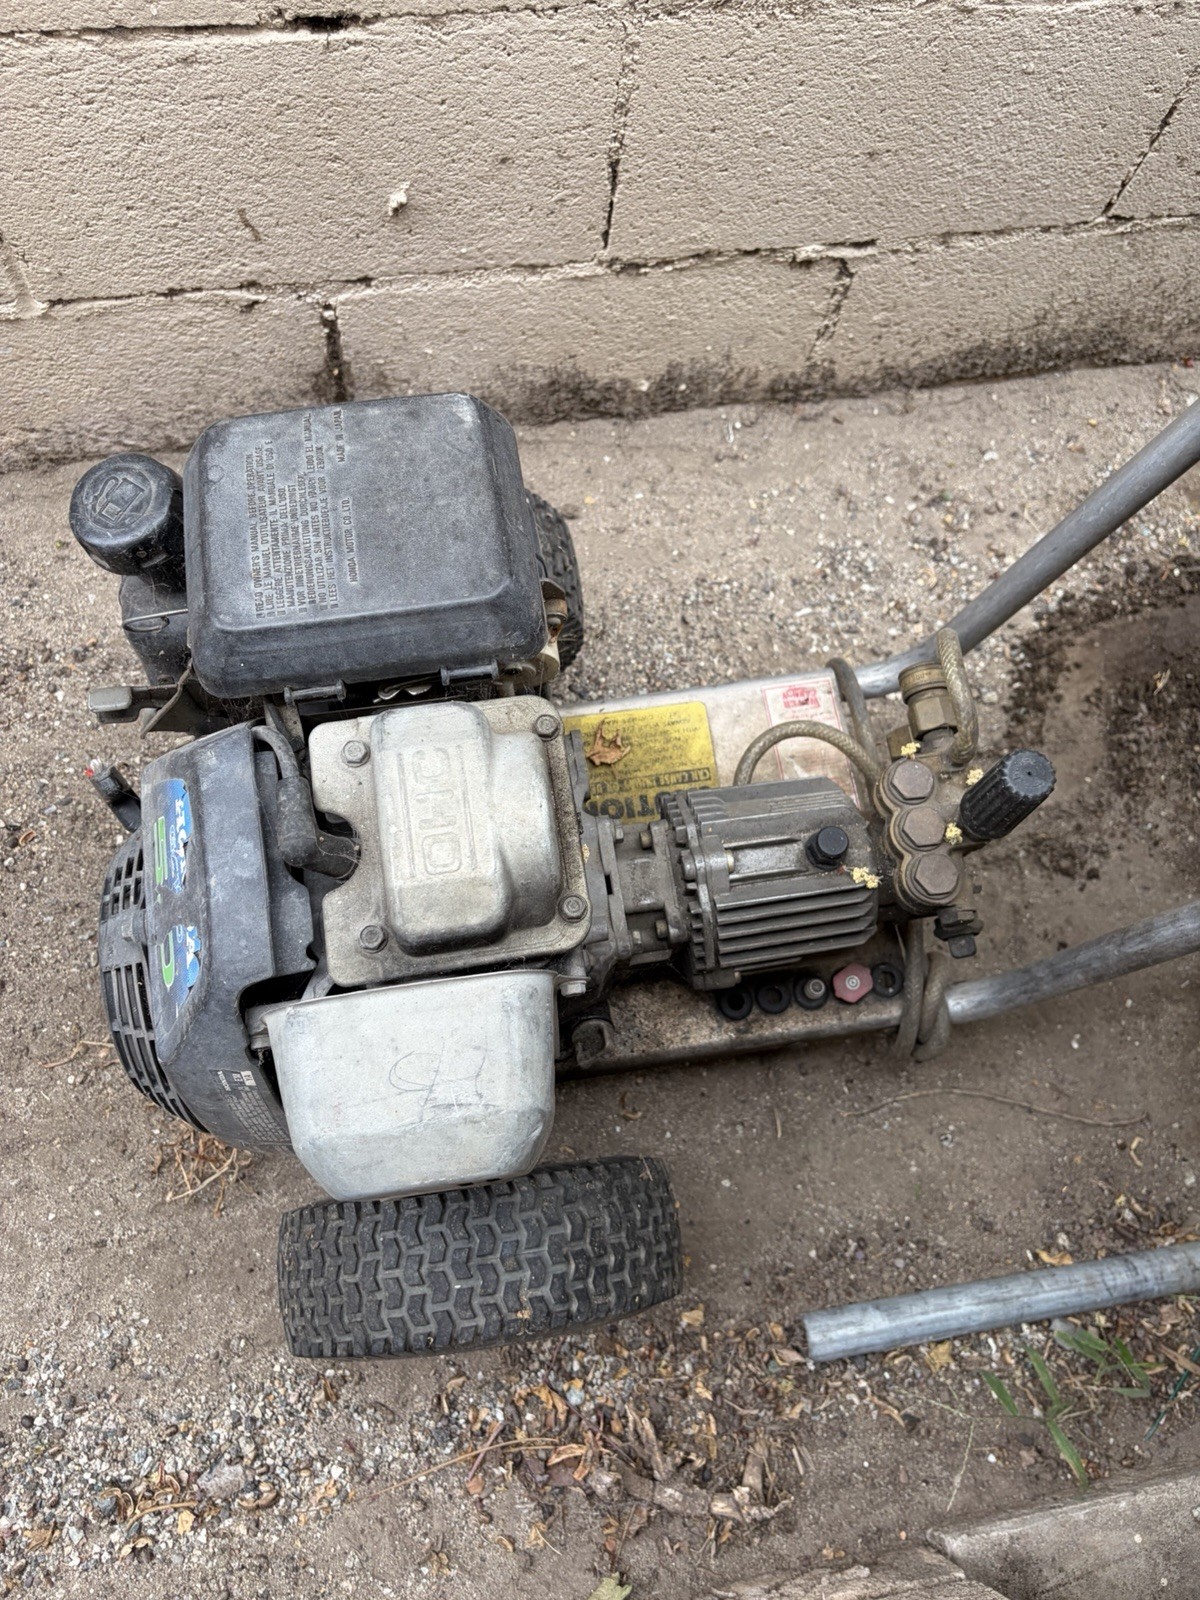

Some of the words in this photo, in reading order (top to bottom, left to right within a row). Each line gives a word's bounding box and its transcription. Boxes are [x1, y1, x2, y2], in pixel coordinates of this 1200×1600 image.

[265, 448, 273, 460] USO
[256, 470, 265, 491] AVANT
[267, 473, 276, 505] MANUALE
[310, 502, 318, 511] NO
[250, 522, 258, 552] MANUAL
[311, 515, 320, 537] ANTES
[270, 519, 281, 573] ATTENTAMENTE
[313, 541, 322, 553] SIN
[345, 528, 354, 553] MOTOR
[261, 548, 271, 578] MANUEL
[292, 525, 304, 587] INBETRIEBNAHME
[252, 556, 261, 588] OWNER'S
[283, 551, 295, 607] MANUTENZIONE
[315, 557, 325, 589] UTILIZAR
[326, 567, 335, 580] HET
[349, 557, 358, 582] HONDA
[264, 581, 272, 590] LE
[328, 584, 337, 601] LEES
[254, 592, 263, 611] READ
[265, 594, 274, 610] LIRE
[296, 591, 306, 605] VOR
[318, 593, 326, 603] NO
[411, 747, 462, 876] OHC
